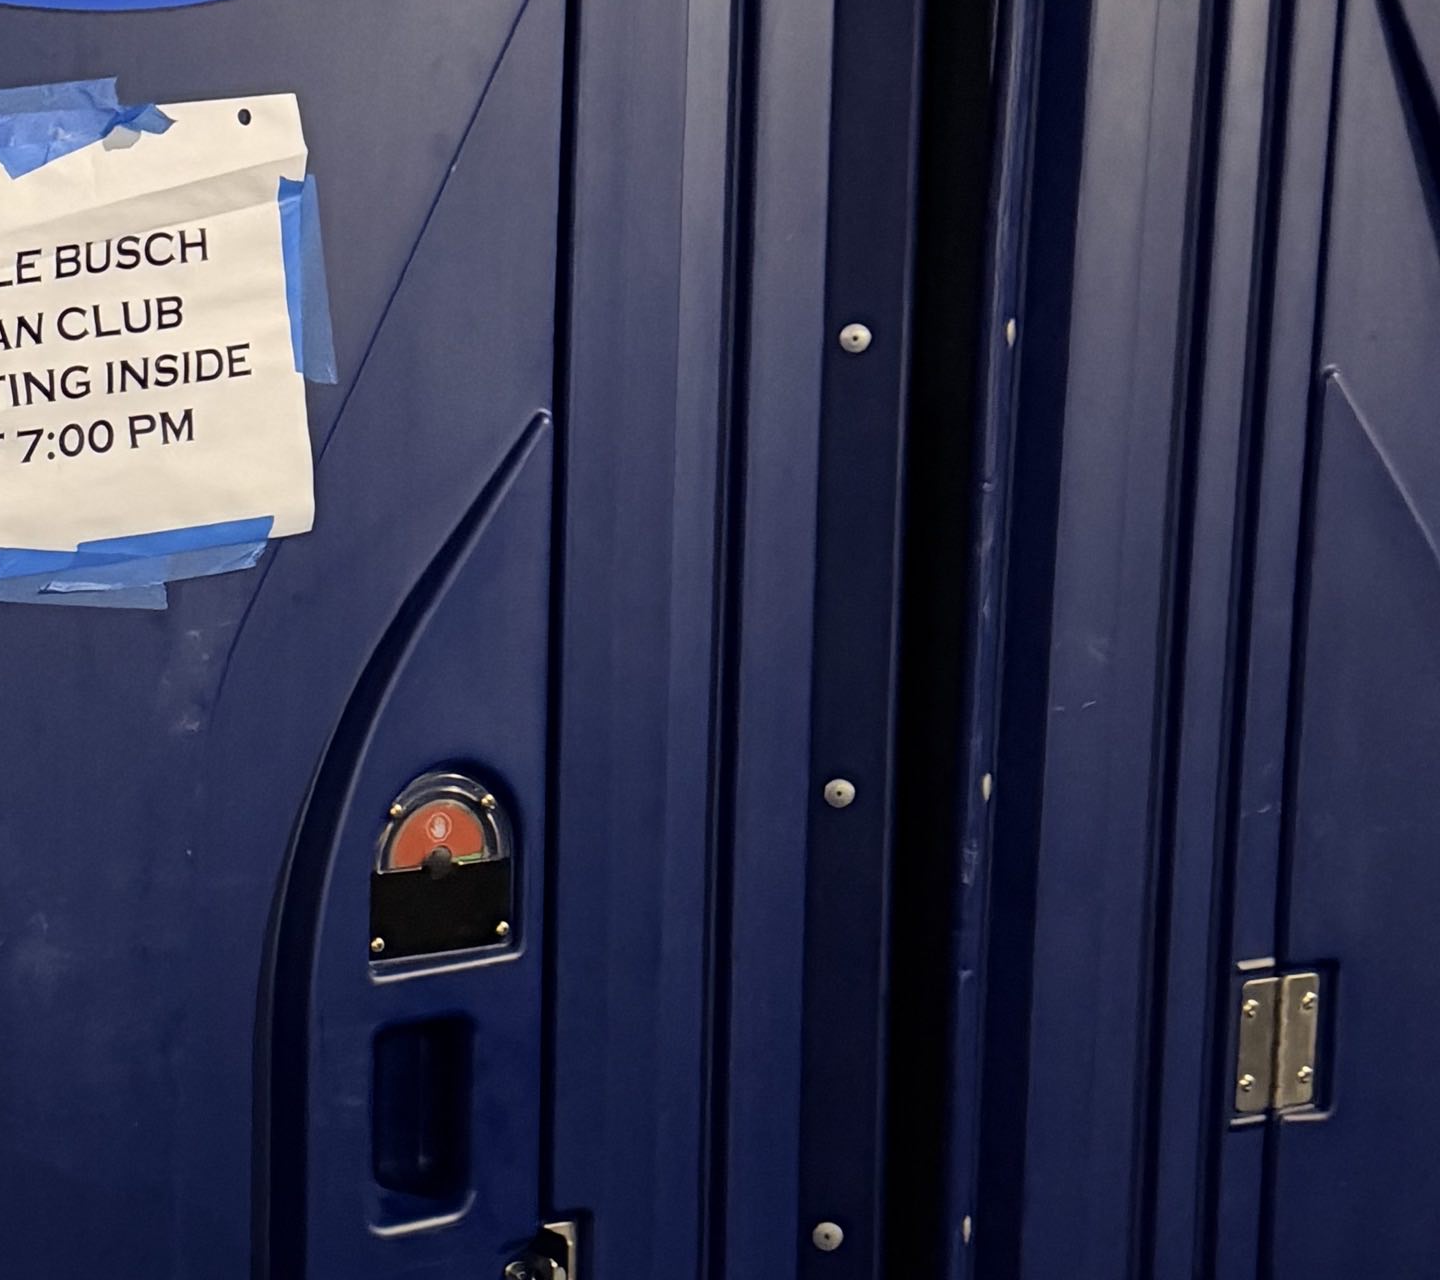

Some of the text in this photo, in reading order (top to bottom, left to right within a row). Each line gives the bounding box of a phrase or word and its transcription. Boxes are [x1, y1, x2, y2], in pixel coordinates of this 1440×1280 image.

[54, 227, 210, 280] BUSCH
[56, 295, 185, 343] CLUB
[105, 342, 253, 395] INSIDE
[16, 418, 115, 464] 7:00
[128, 407, 195, 450] PM
